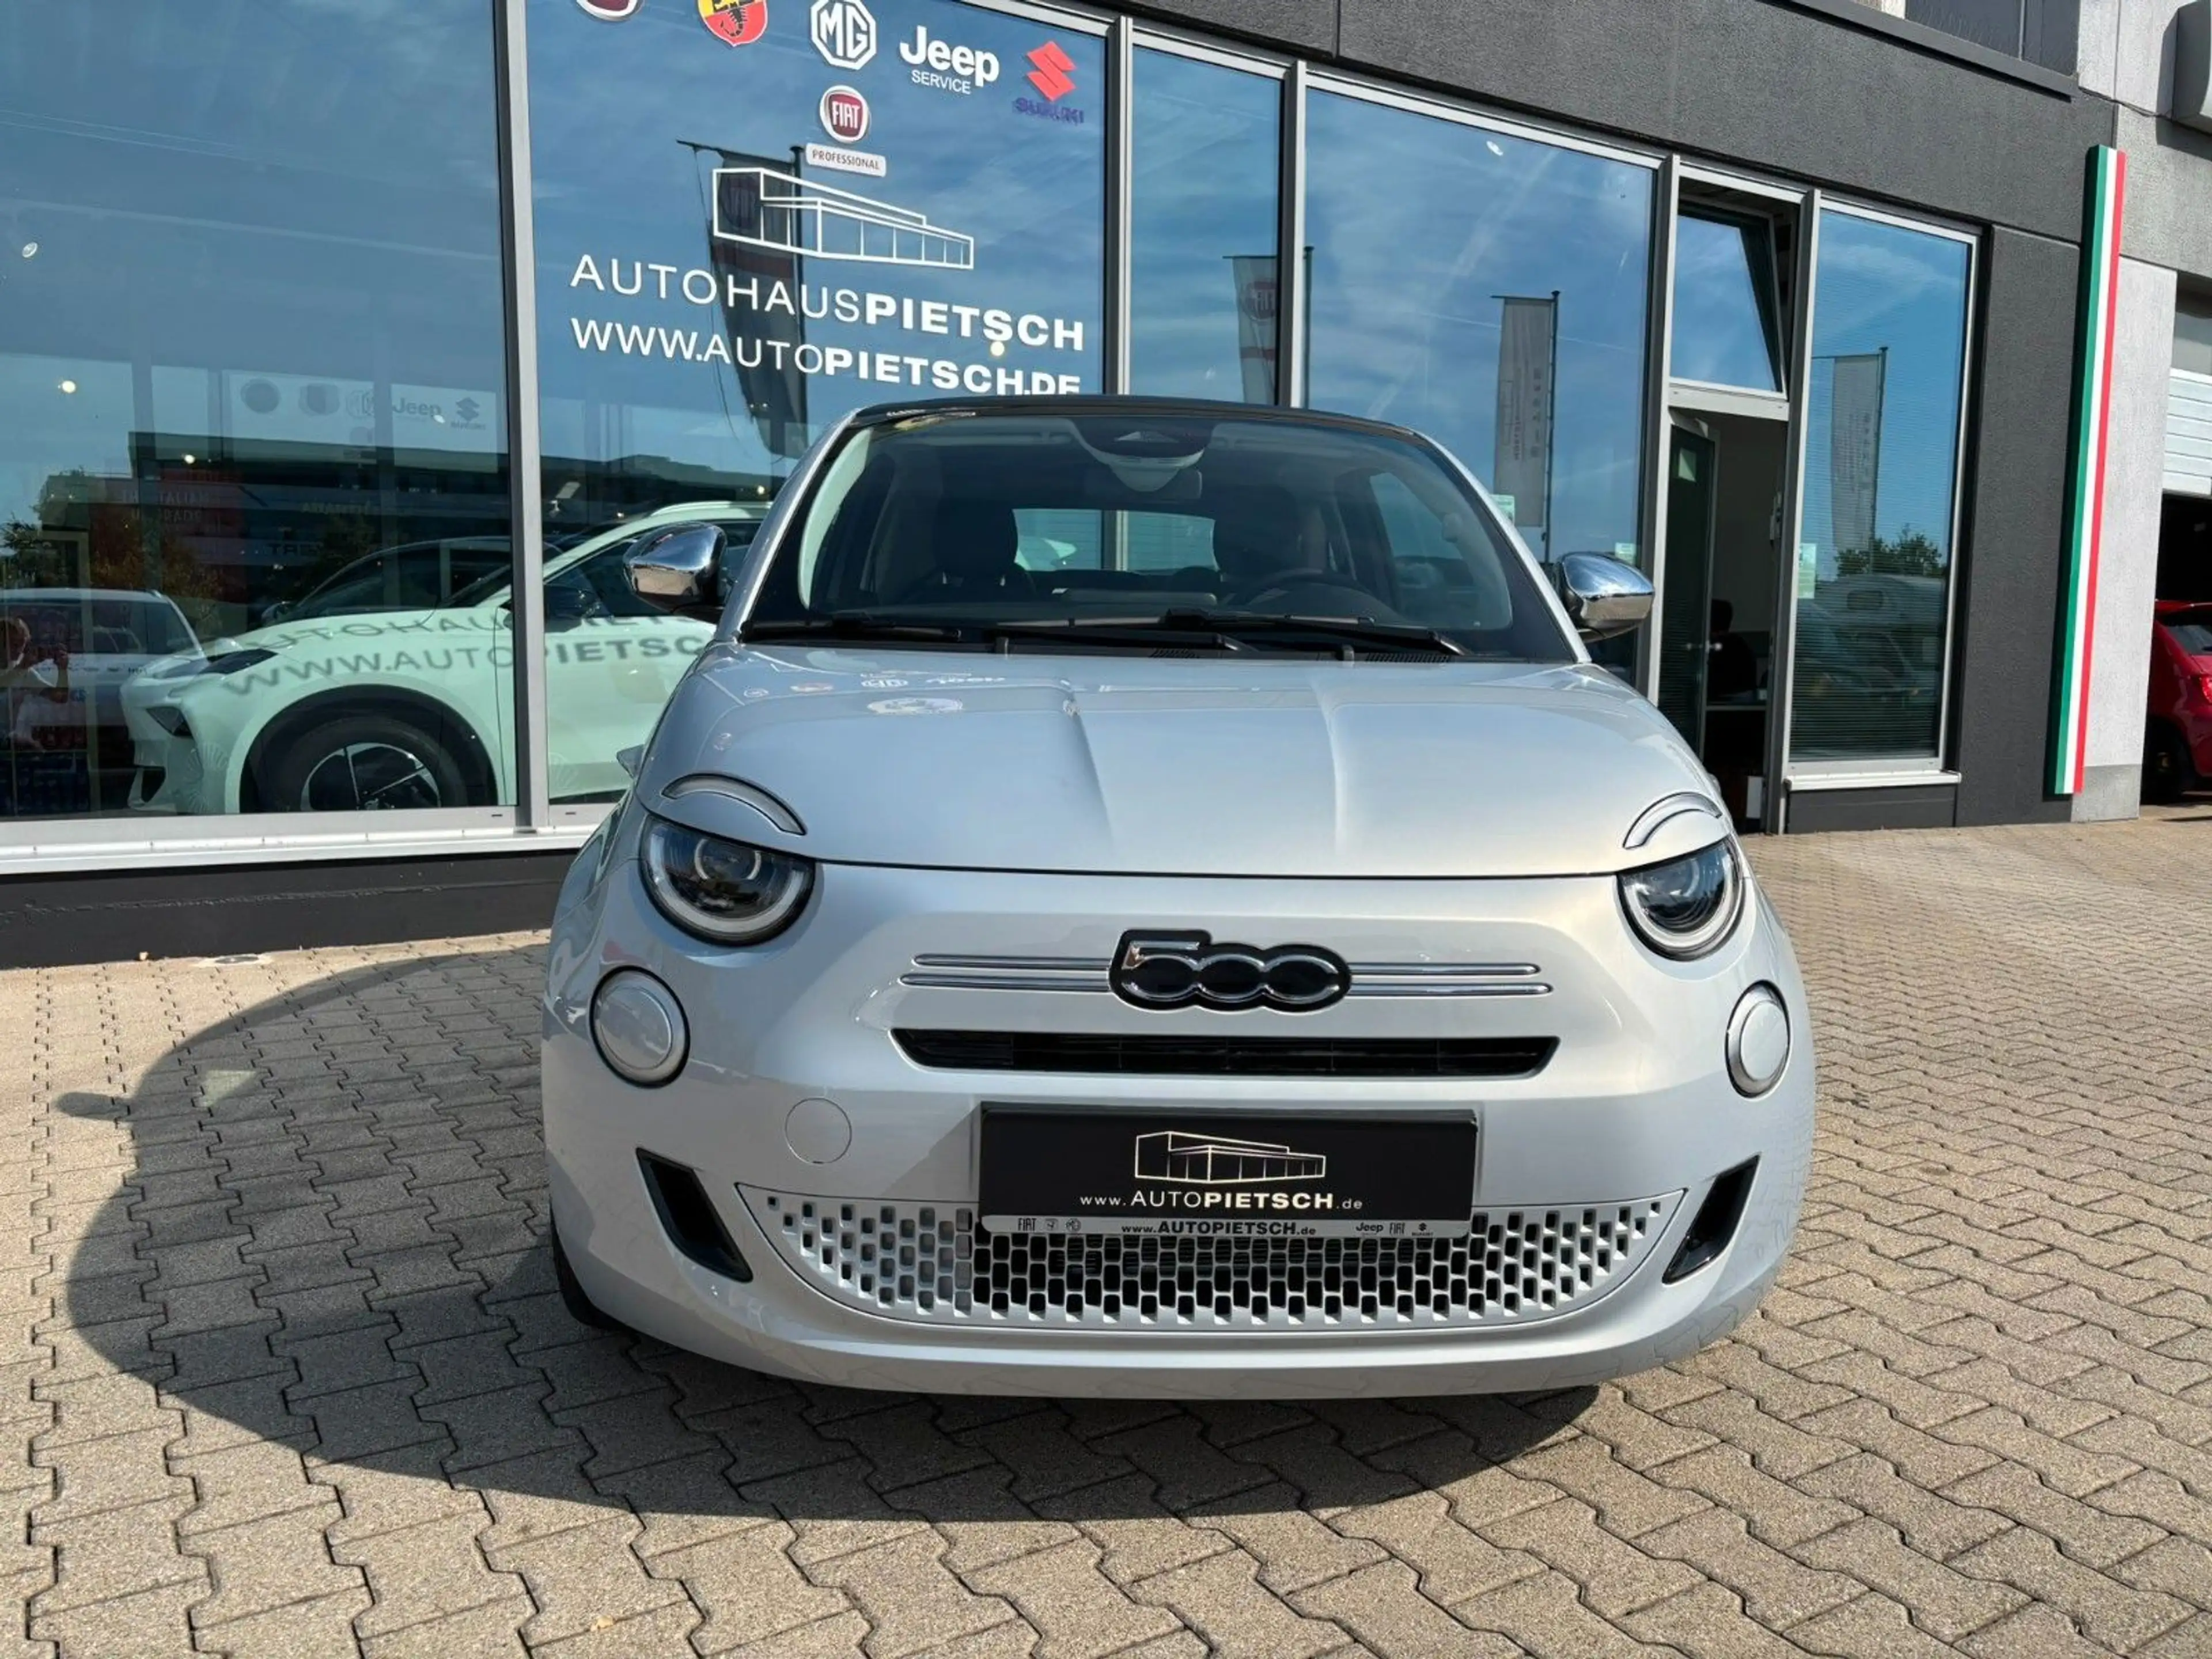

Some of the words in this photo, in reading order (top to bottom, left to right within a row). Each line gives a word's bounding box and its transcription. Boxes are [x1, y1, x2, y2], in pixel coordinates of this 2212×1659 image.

[820, 2, 869, 59] MG
[900, 25, 999, 87] Jeep
[911, 69, 971, 95] SERVICE
[832, 101, 861, 129] FIAT
[812, 149, 880, 170] PROFESSIONAL
[571, 254, 1084, 351] AUTOHAUSPIETSCH
[1111, 931, 1350, 1012] 500
[1080, 1190, 1363, 1210] www.AUTOPIETSCH.de
[1121, 1221, 1317, 1236] www.AUTOPIETSCH.de
[1355, 1222, 1384, 1233] Jeep
